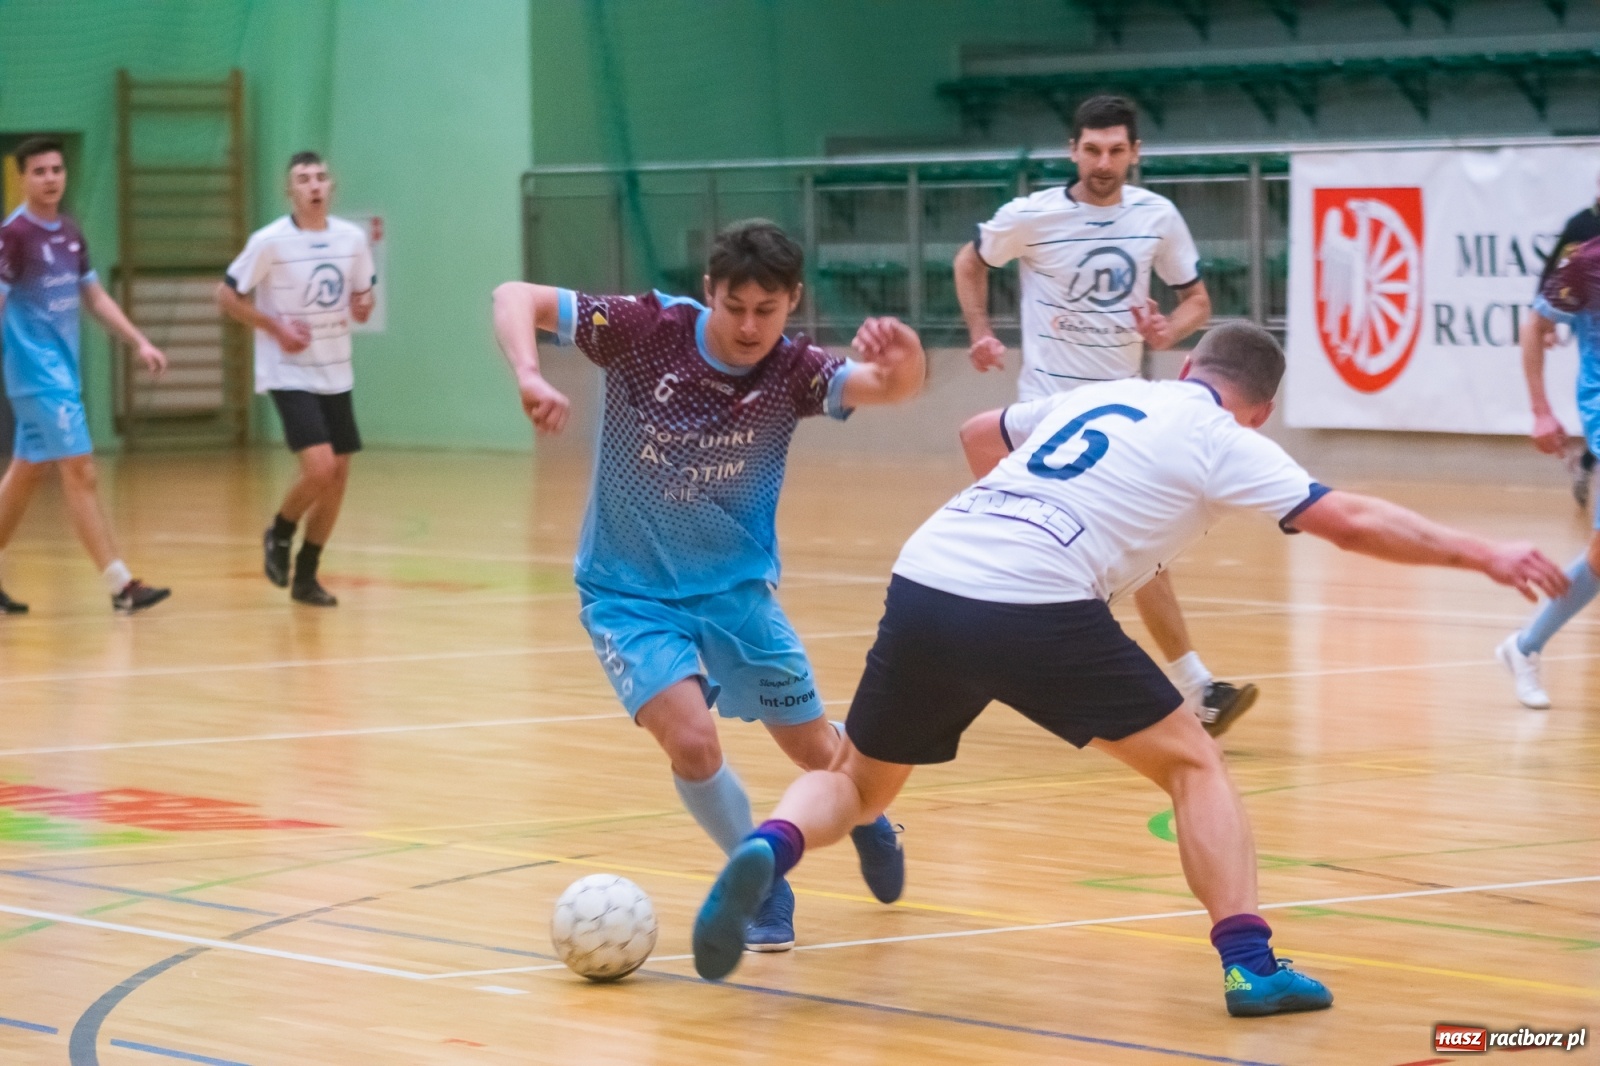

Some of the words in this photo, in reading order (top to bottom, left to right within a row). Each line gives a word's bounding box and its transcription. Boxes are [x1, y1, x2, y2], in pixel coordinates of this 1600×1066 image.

[1455, 233, 1561, 277] MIAS
[1432, 302, 1574, 347] RACI
[654, 373, 679, 403] 6
[1026, 403, 1147, 480] 6
[759, 688, 815, 708] Int-Drew
